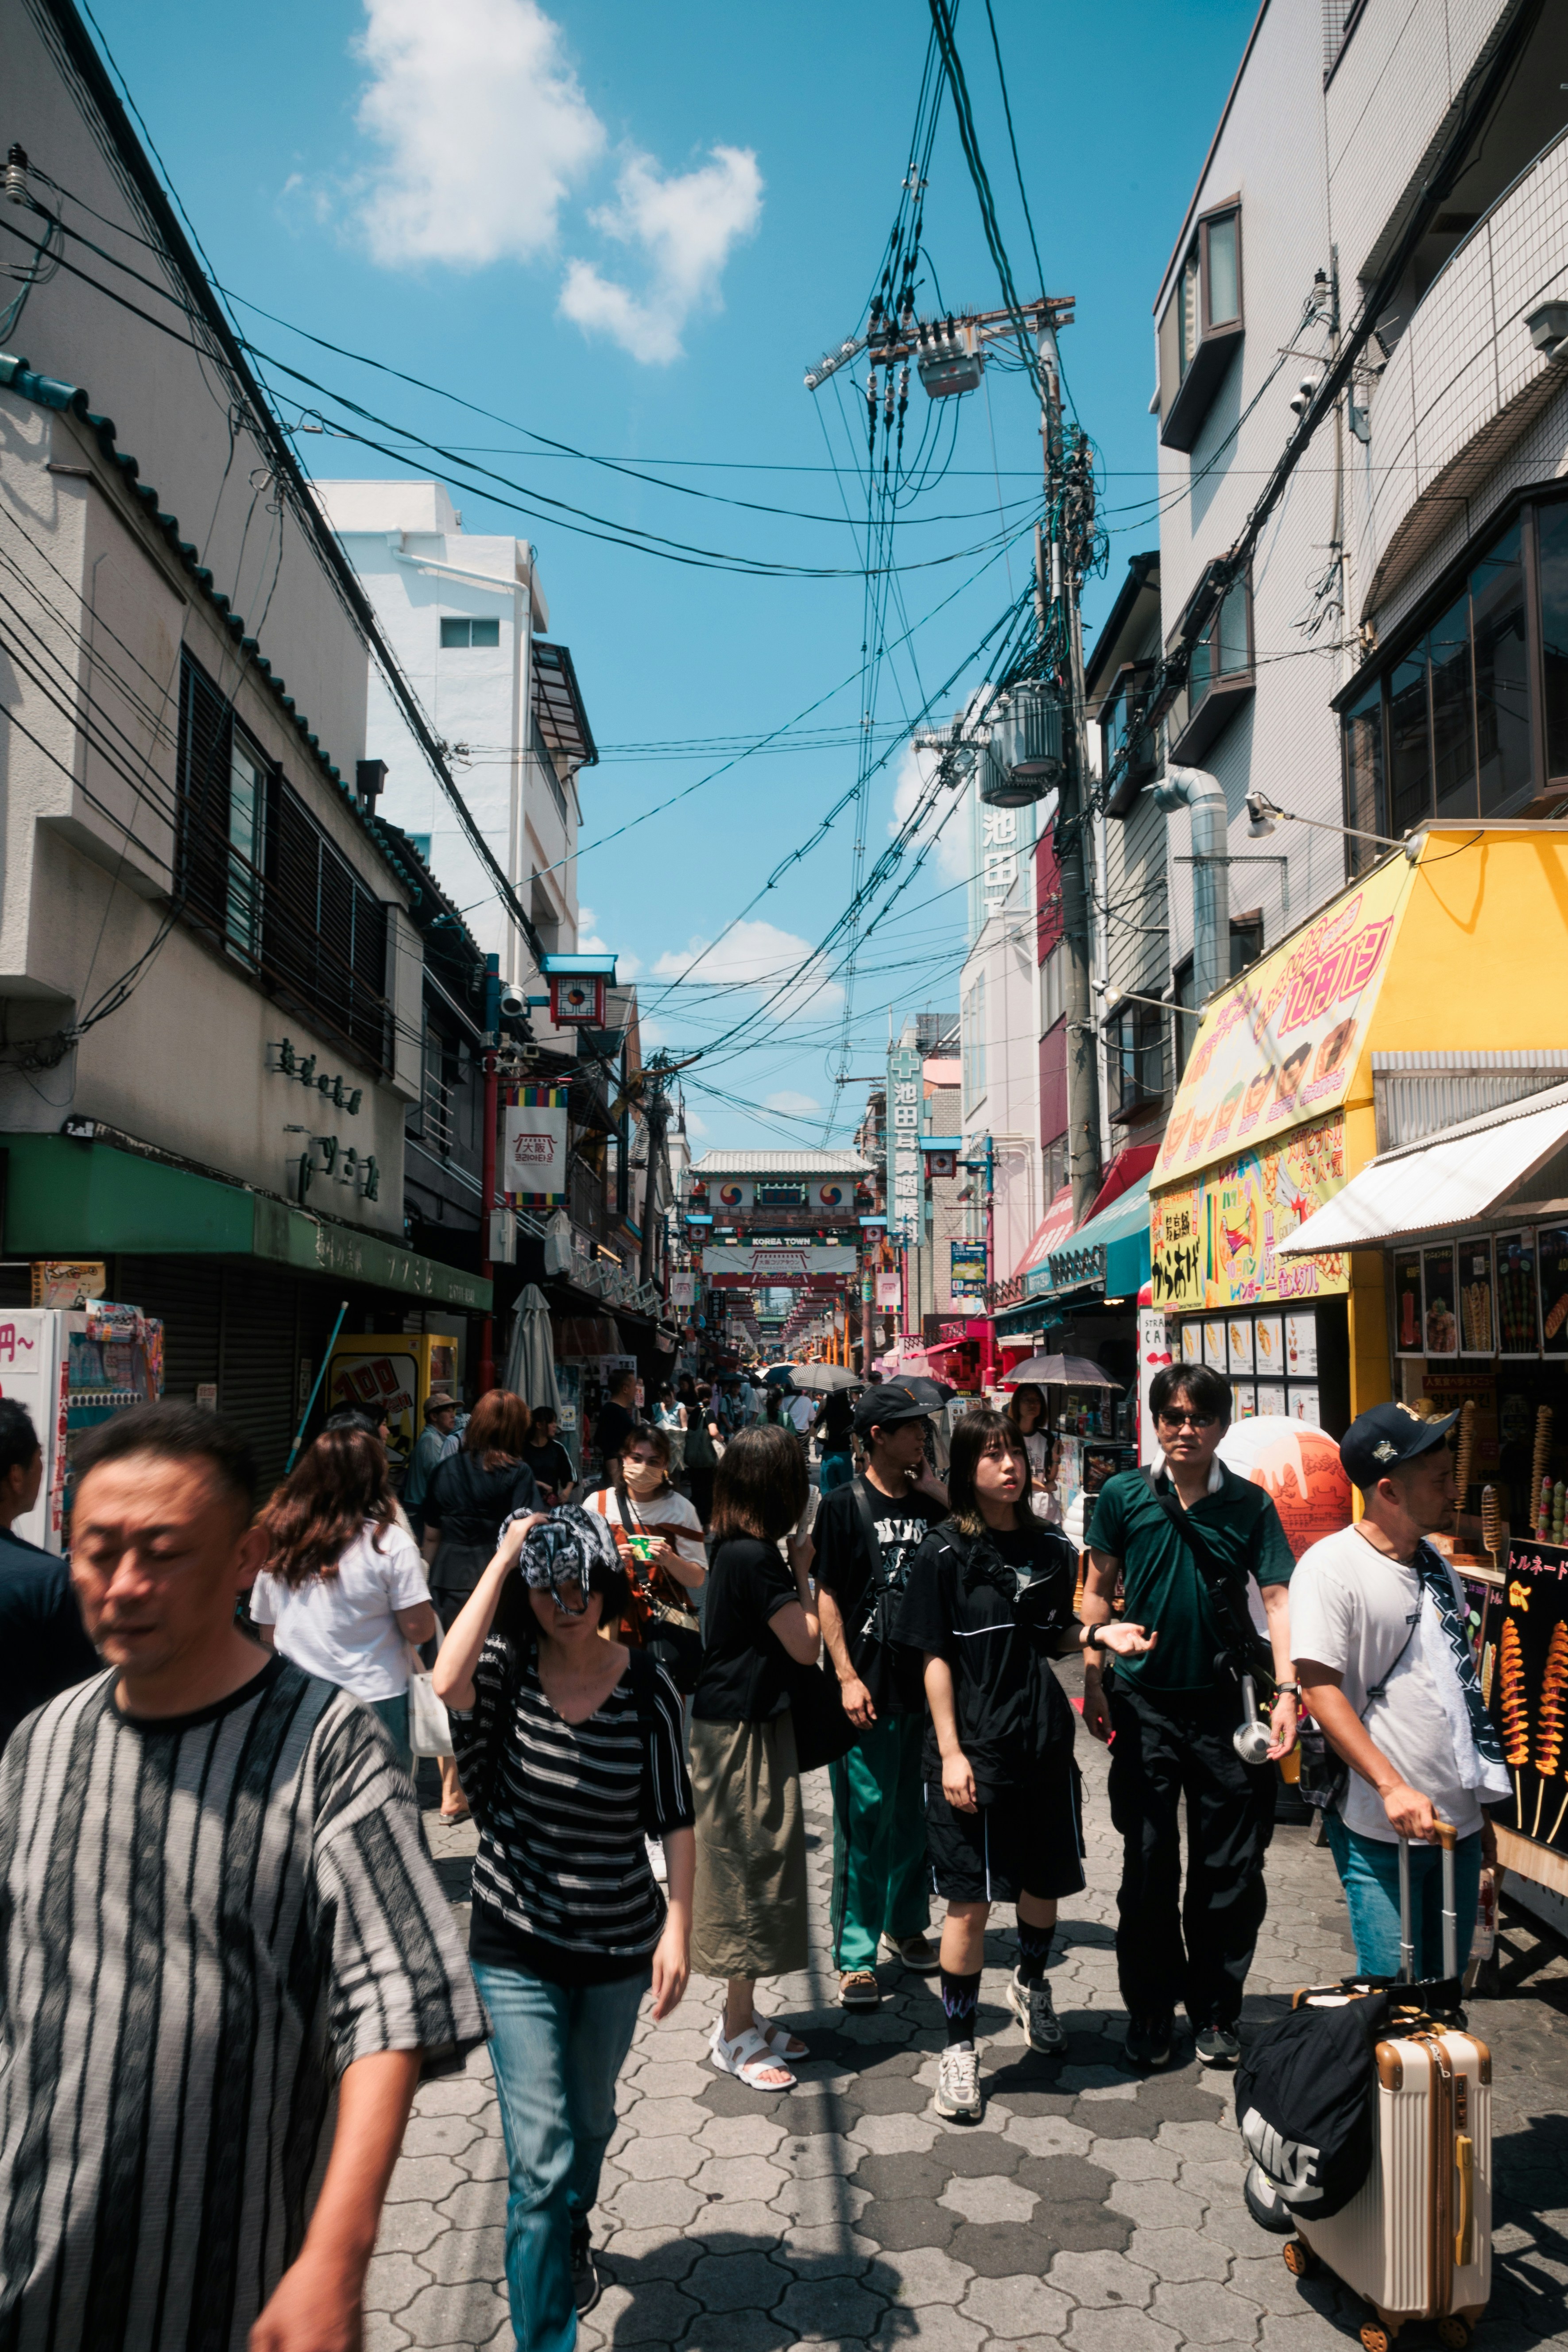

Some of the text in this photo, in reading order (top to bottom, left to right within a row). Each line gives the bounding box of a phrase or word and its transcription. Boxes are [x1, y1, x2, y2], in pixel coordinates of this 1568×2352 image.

[1278, 919, 1393, 1036] 10円パン
[515, 1153, 553, 1163] 코리아타운
[523, 1143, 545, 1153] 大阪
[894, 1082, 919, 1243] 池田耳鼻咽喉科
[1152, 1234, 1200, 1300] からあげ
[1278, 1263, 1319, 1298] 金メダル
[1230, 1279, 1262, 1302] レインボー
[333, 1357, 400, 1403] 100
[1426, 1375, 1495, 1388] 人気食べ歩きメニュー
[1508, 1551, 1568, 1580] トルネード
[1512, 1587, 1522, 1597] NEW
